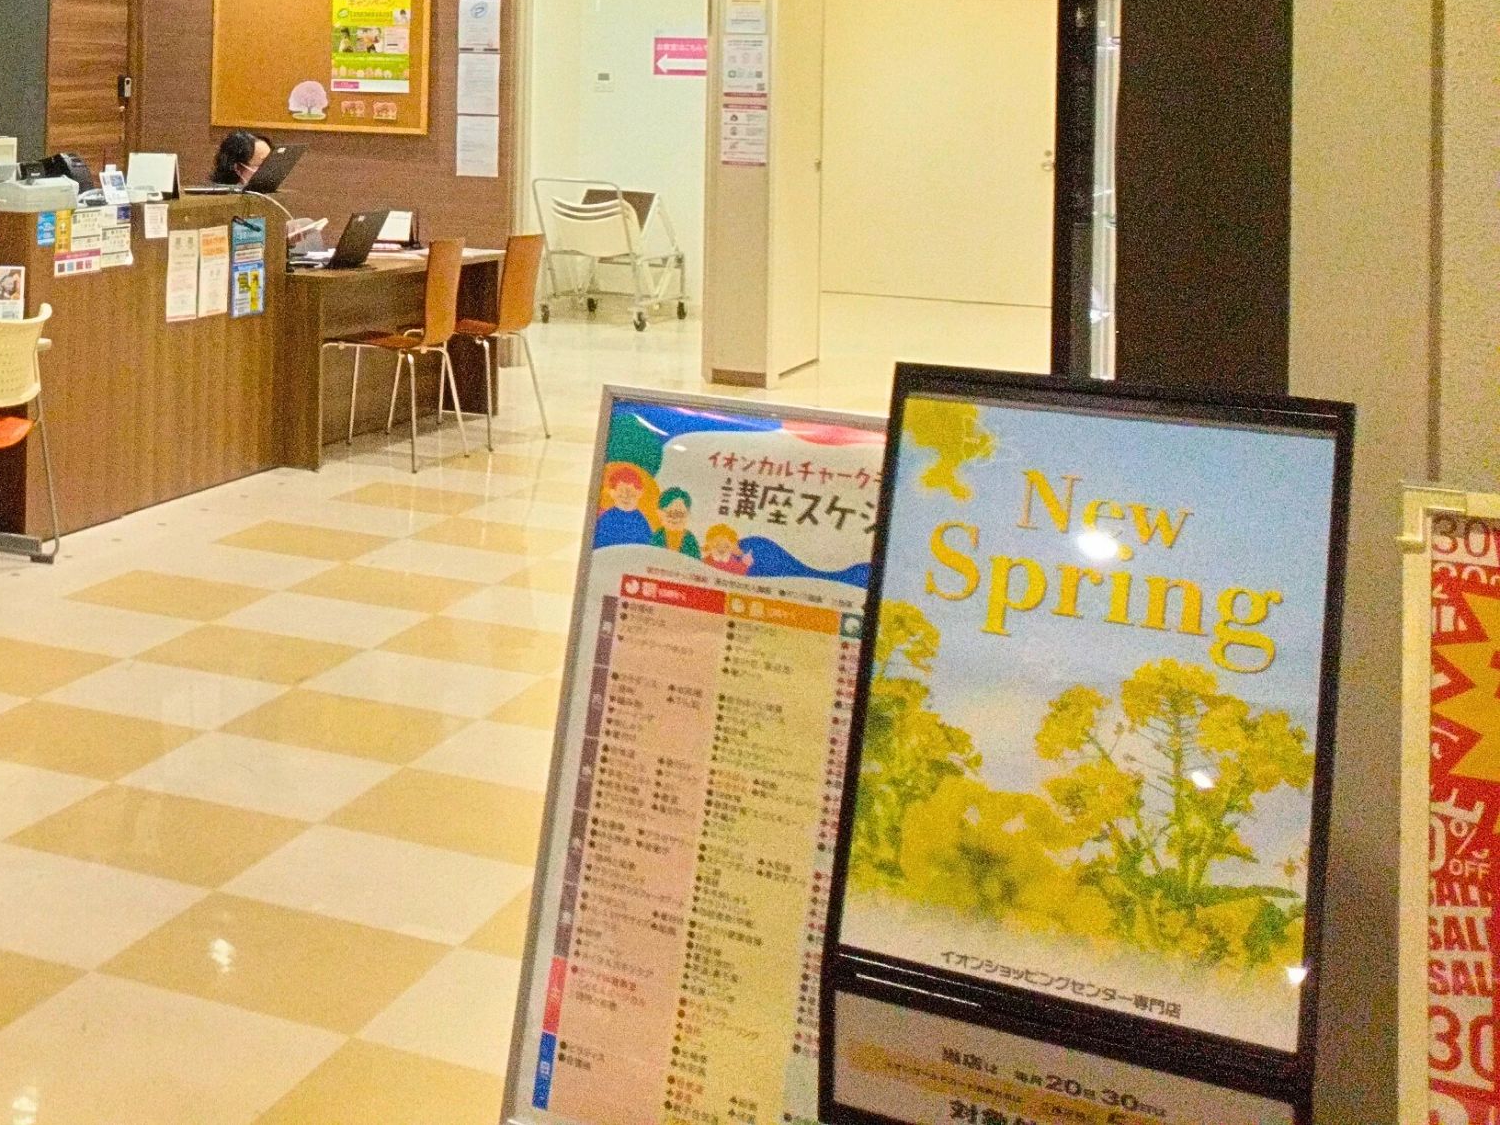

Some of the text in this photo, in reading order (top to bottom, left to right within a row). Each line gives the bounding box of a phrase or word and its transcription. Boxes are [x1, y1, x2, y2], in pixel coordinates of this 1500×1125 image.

[1016, 469, 1194, 550] New
[924, 520, 1284, 674] Spring
[941, 949, 1183, 1021] イオンショッピングセンター専門店
